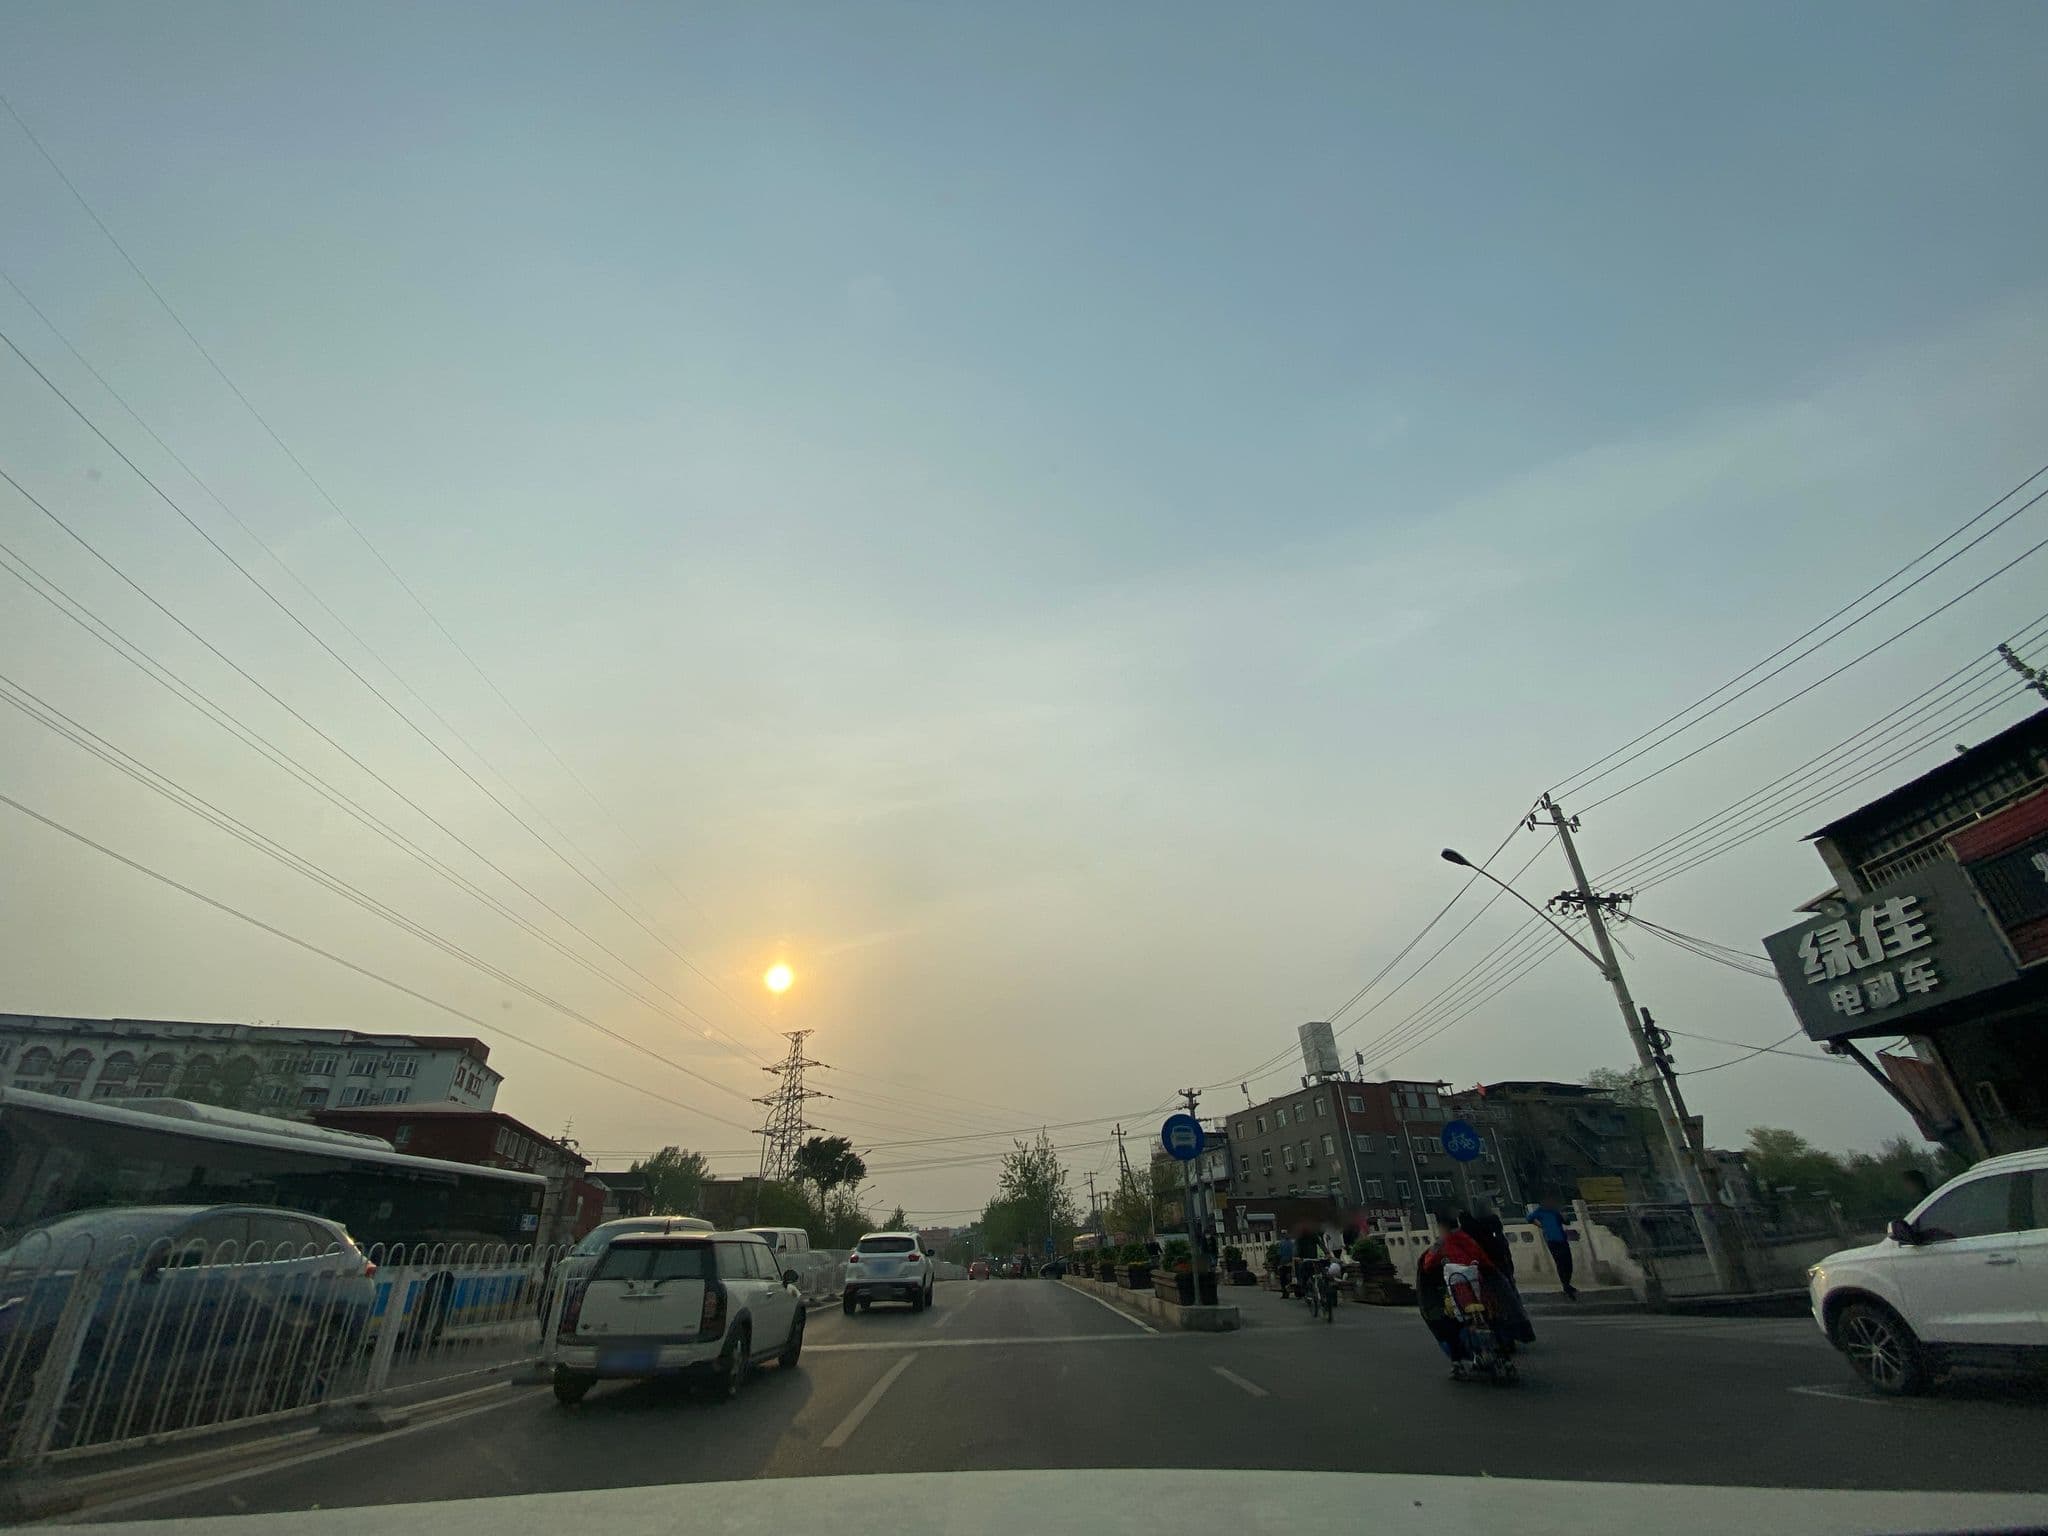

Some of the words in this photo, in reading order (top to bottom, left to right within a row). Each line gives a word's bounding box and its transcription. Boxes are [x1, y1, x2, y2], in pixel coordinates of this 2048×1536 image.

[1798, 895, 1933, 985] 绿佳
[1828, 957, 1940, 1016] 电动车
